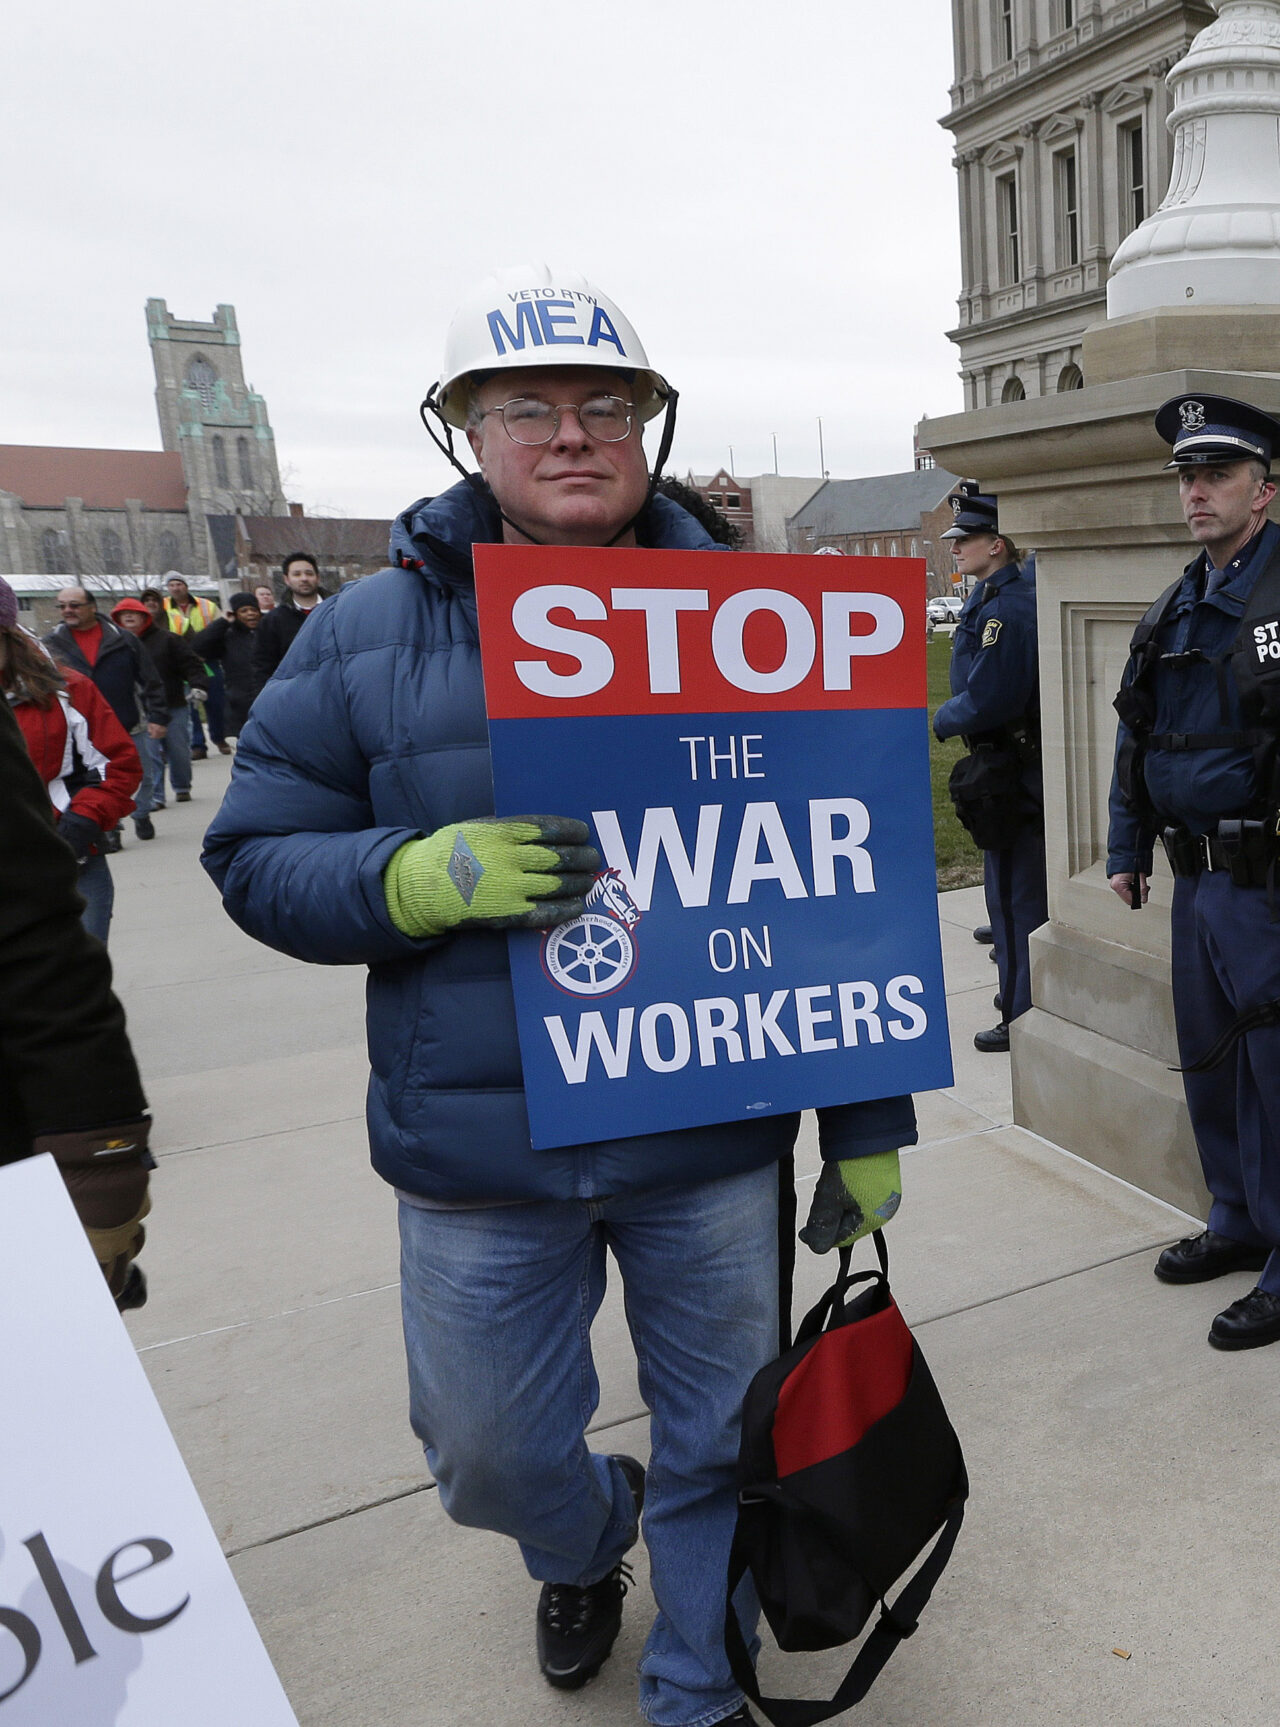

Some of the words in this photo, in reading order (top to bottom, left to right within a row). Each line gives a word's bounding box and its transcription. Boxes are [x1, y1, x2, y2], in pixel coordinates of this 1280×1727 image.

[507, 287, 555, 303] VETO
[560, 288, 598, 306] RTW
[486, 300, 628, 357] MEA
[511, 584, 905, 698] STOP
[679, 734, 765, 781] THE
[592, 797, 876, 912] WAR
[708, 925, 773, 974] ON
[543, 975, 928, 1085] WORKERS
